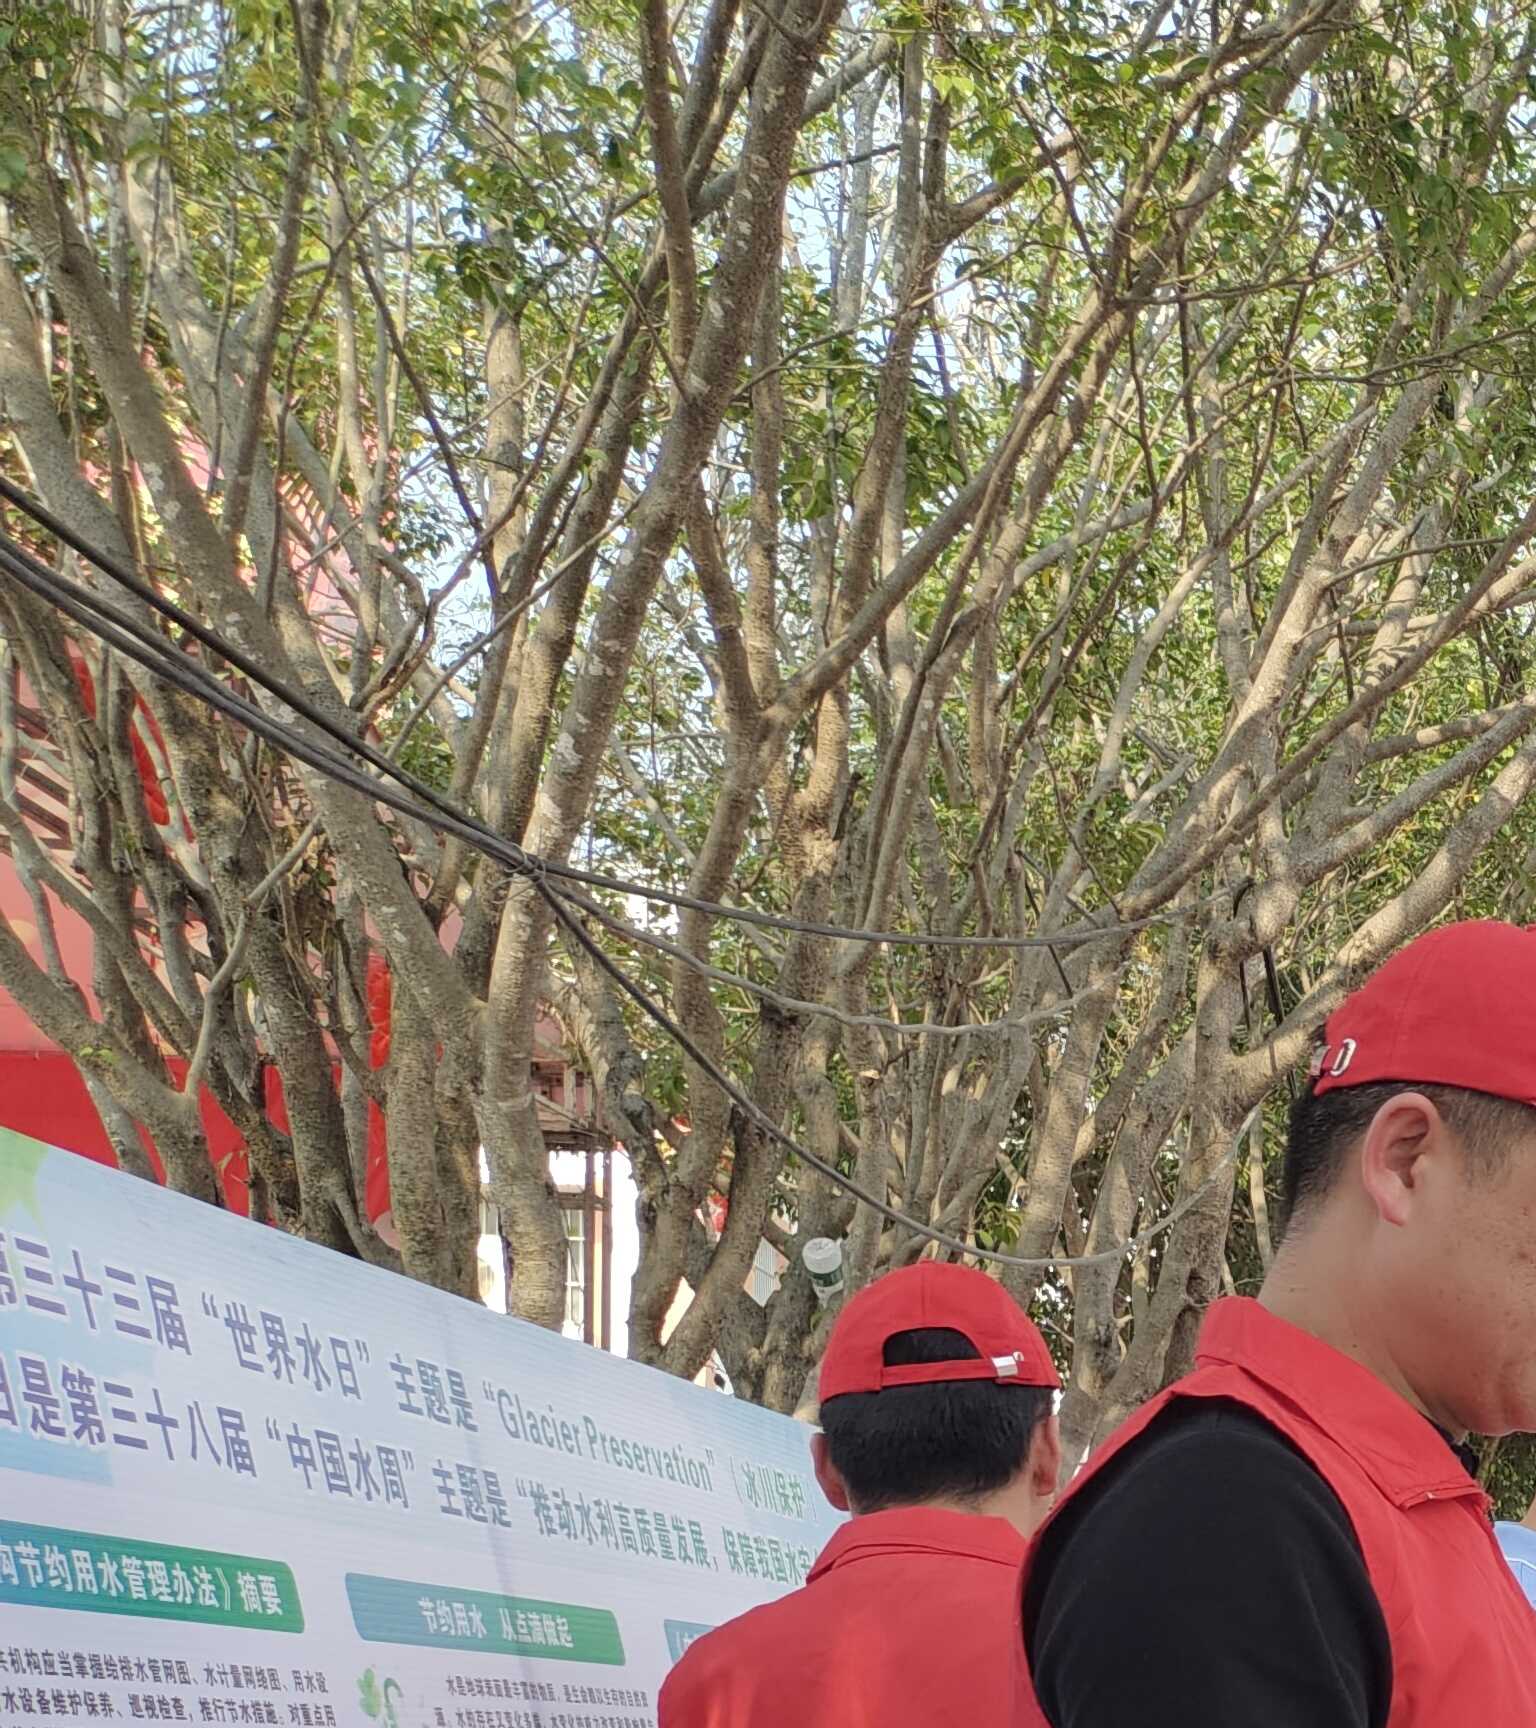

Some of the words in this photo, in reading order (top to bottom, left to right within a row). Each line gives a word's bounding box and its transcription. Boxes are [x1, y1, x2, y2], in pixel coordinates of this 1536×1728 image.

[417, 1597, 488, 1639] 节约用水
[499, 1608, 574, 1648] 从点滴做起
[0, 1687, 337, 1727] 水设备维护保养、巡视检查，推行节水措施。对重点用
